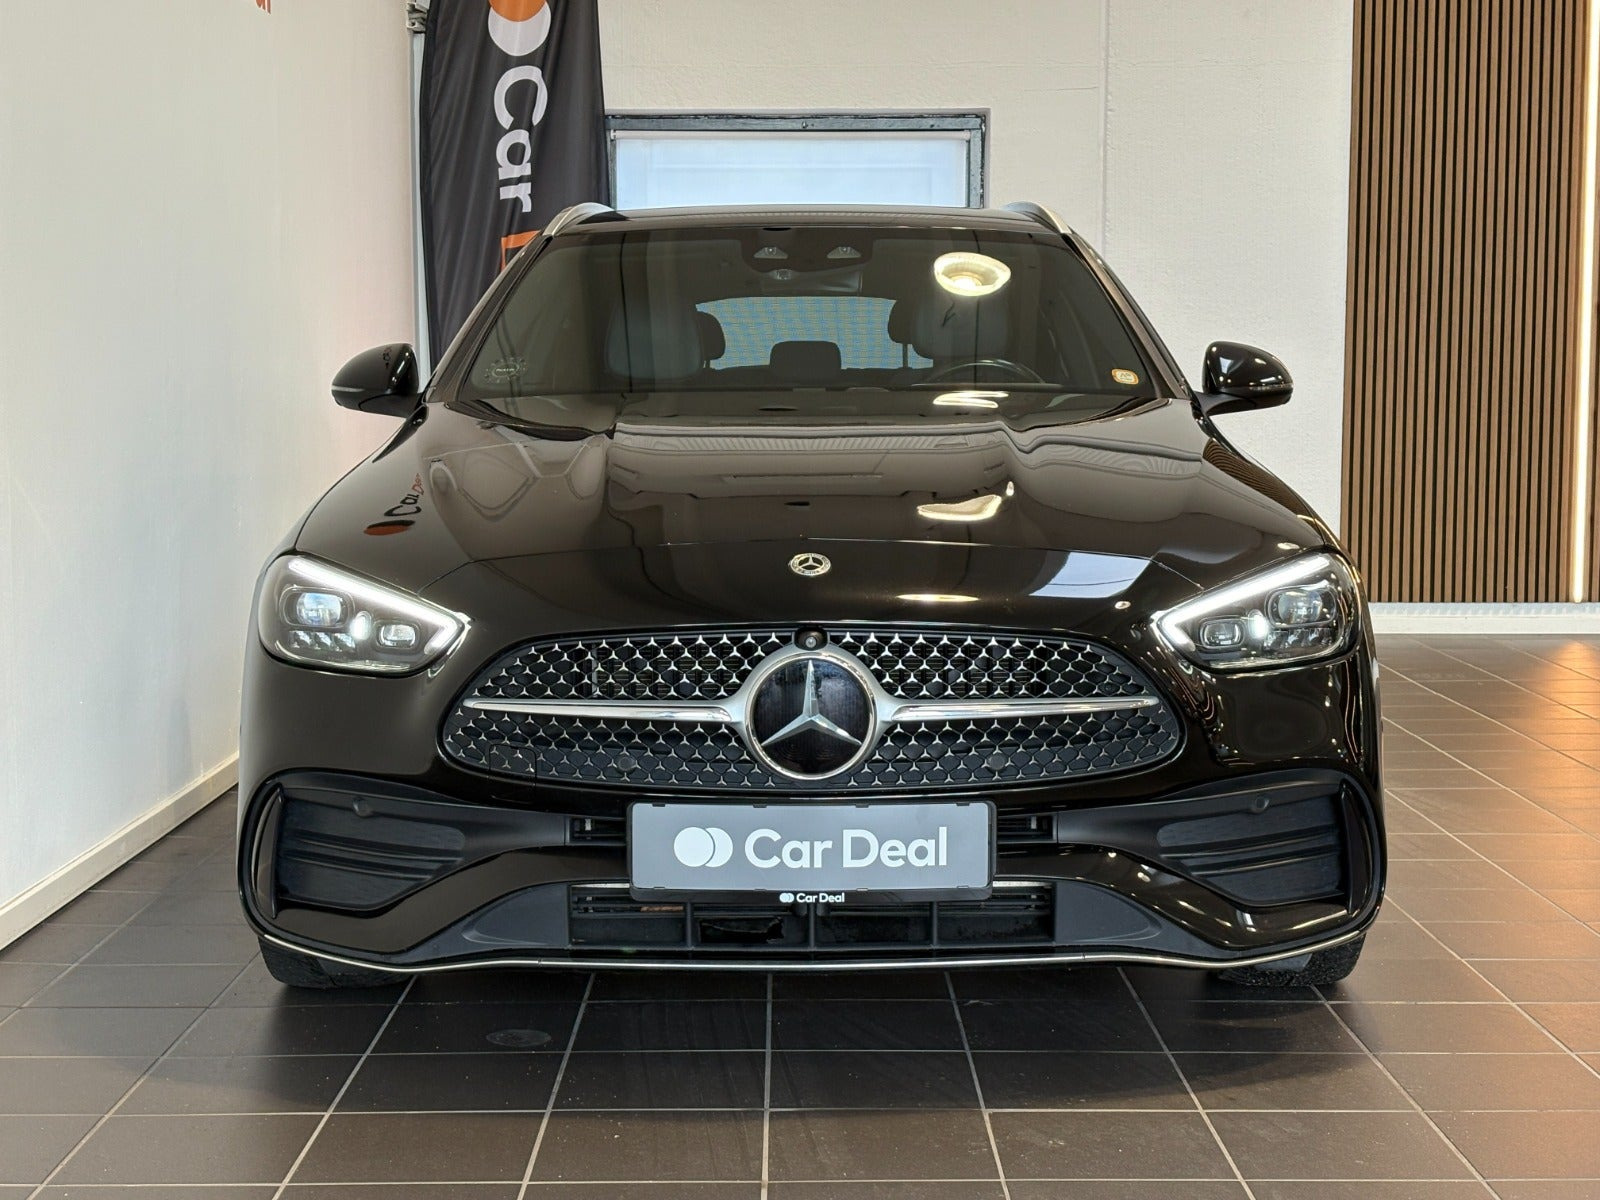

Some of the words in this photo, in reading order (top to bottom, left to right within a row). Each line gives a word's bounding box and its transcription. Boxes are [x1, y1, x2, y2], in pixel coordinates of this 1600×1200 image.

[494, 65, 548, 212] Car
[744, 828, 833, 869] Car
[842, 826, 948, 868] Deal
[796, 892, 818, 903] Car
[818, 892, 846, 903] Deal
